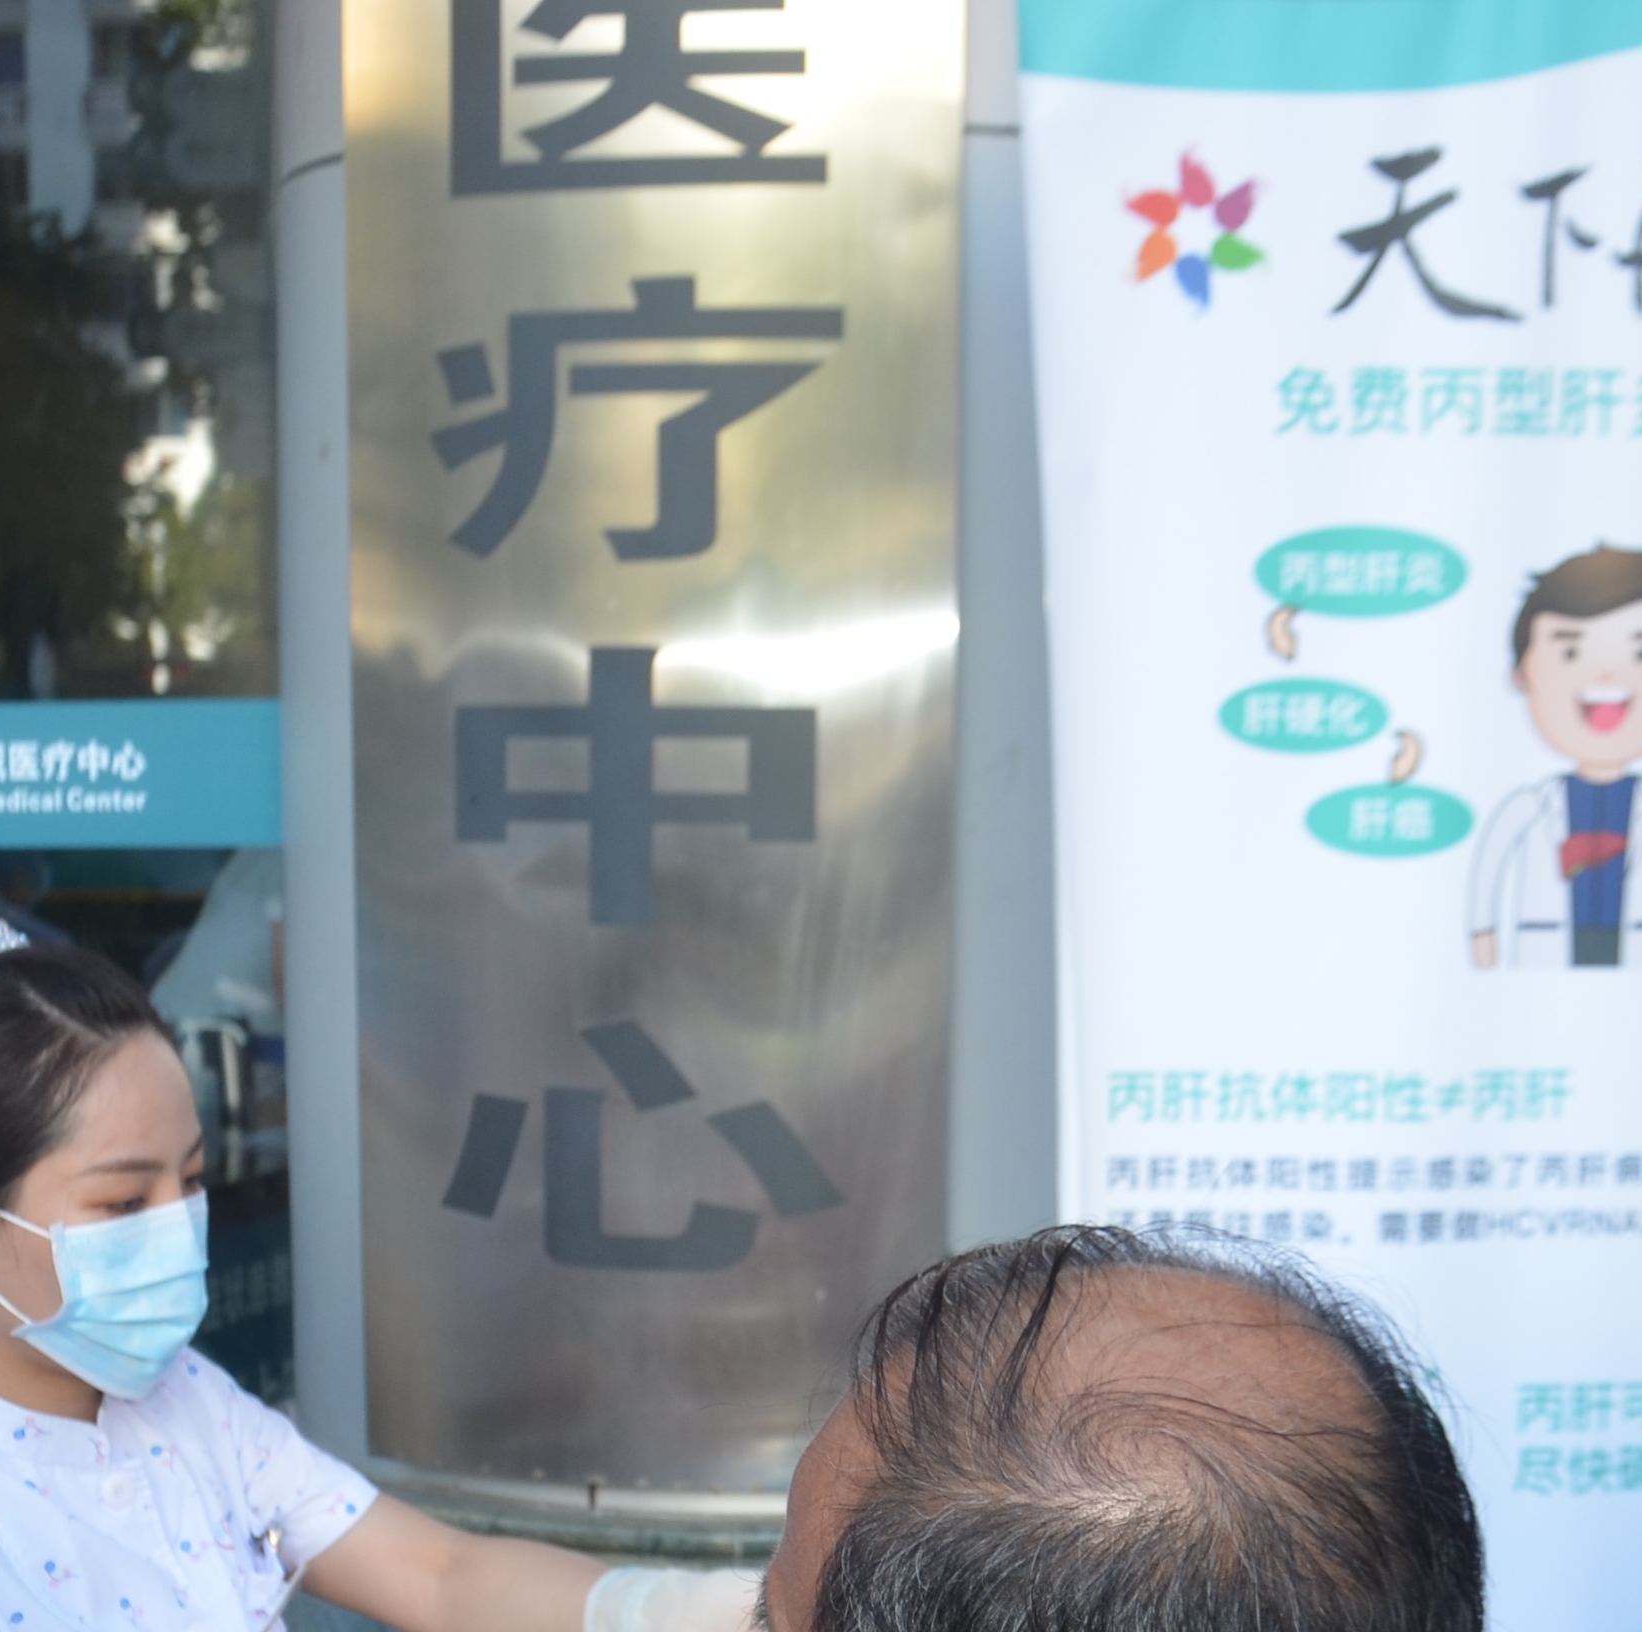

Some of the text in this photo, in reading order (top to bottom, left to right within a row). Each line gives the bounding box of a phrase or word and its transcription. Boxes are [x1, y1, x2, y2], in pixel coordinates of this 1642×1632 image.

[1277, 550, 1447, 597] 丙型肝炎
[430, 0, 847, 1274] 医疗中心
[1240, 694, 1369, 738] 肝硬化
[66, 785, 148, 812] Center
[1107, 1067, 1572, 1123] 丙肝抗体阳性≠丙肝
